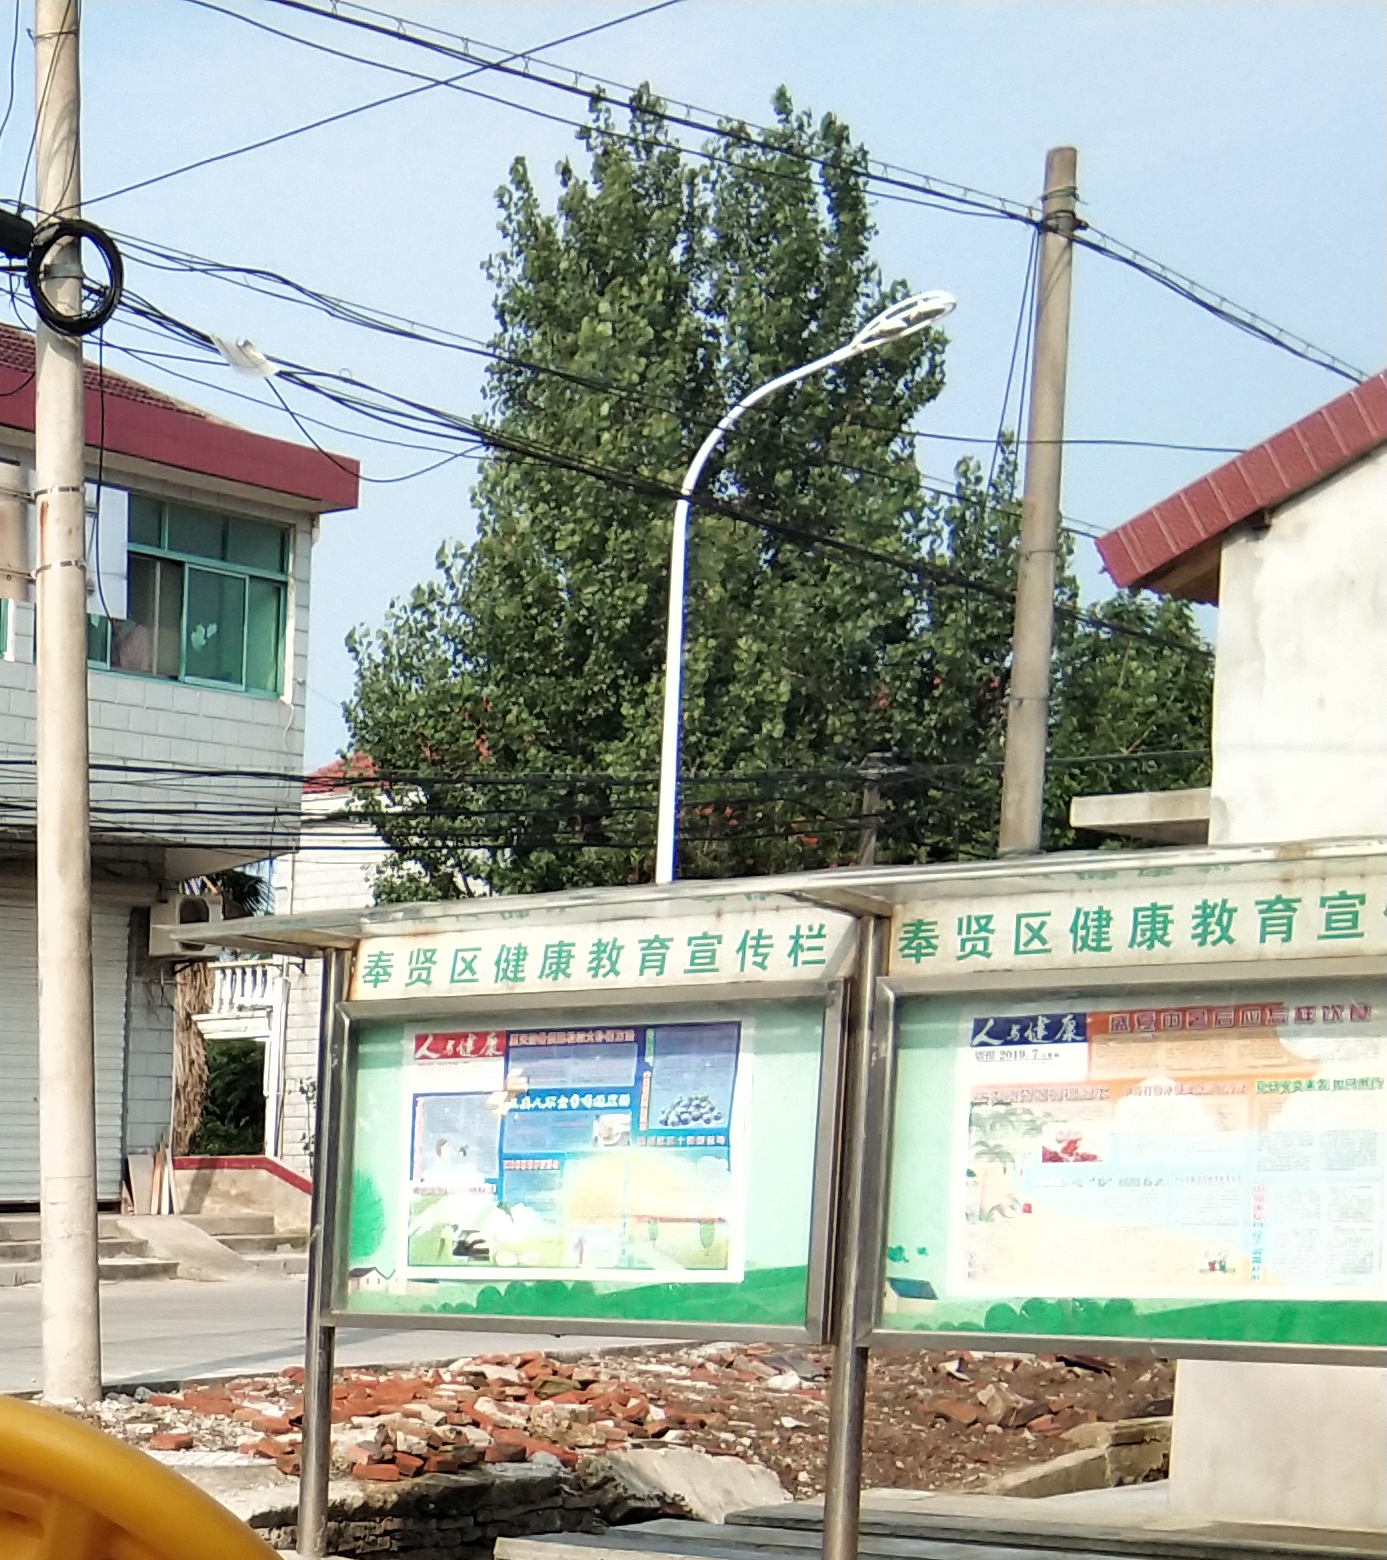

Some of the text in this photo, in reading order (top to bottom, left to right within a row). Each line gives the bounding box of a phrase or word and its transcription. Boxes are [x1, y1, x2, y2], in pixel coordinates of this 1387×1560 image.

[898, 890, 1387, 964] 奉贤区健康教育宣
[362, 923, 827, 988] 奉贤区健康教育宣传栏
[415, 1032, 503, 1060] 人与健康
[973, 1013, 1084, 1047] 人与健康
